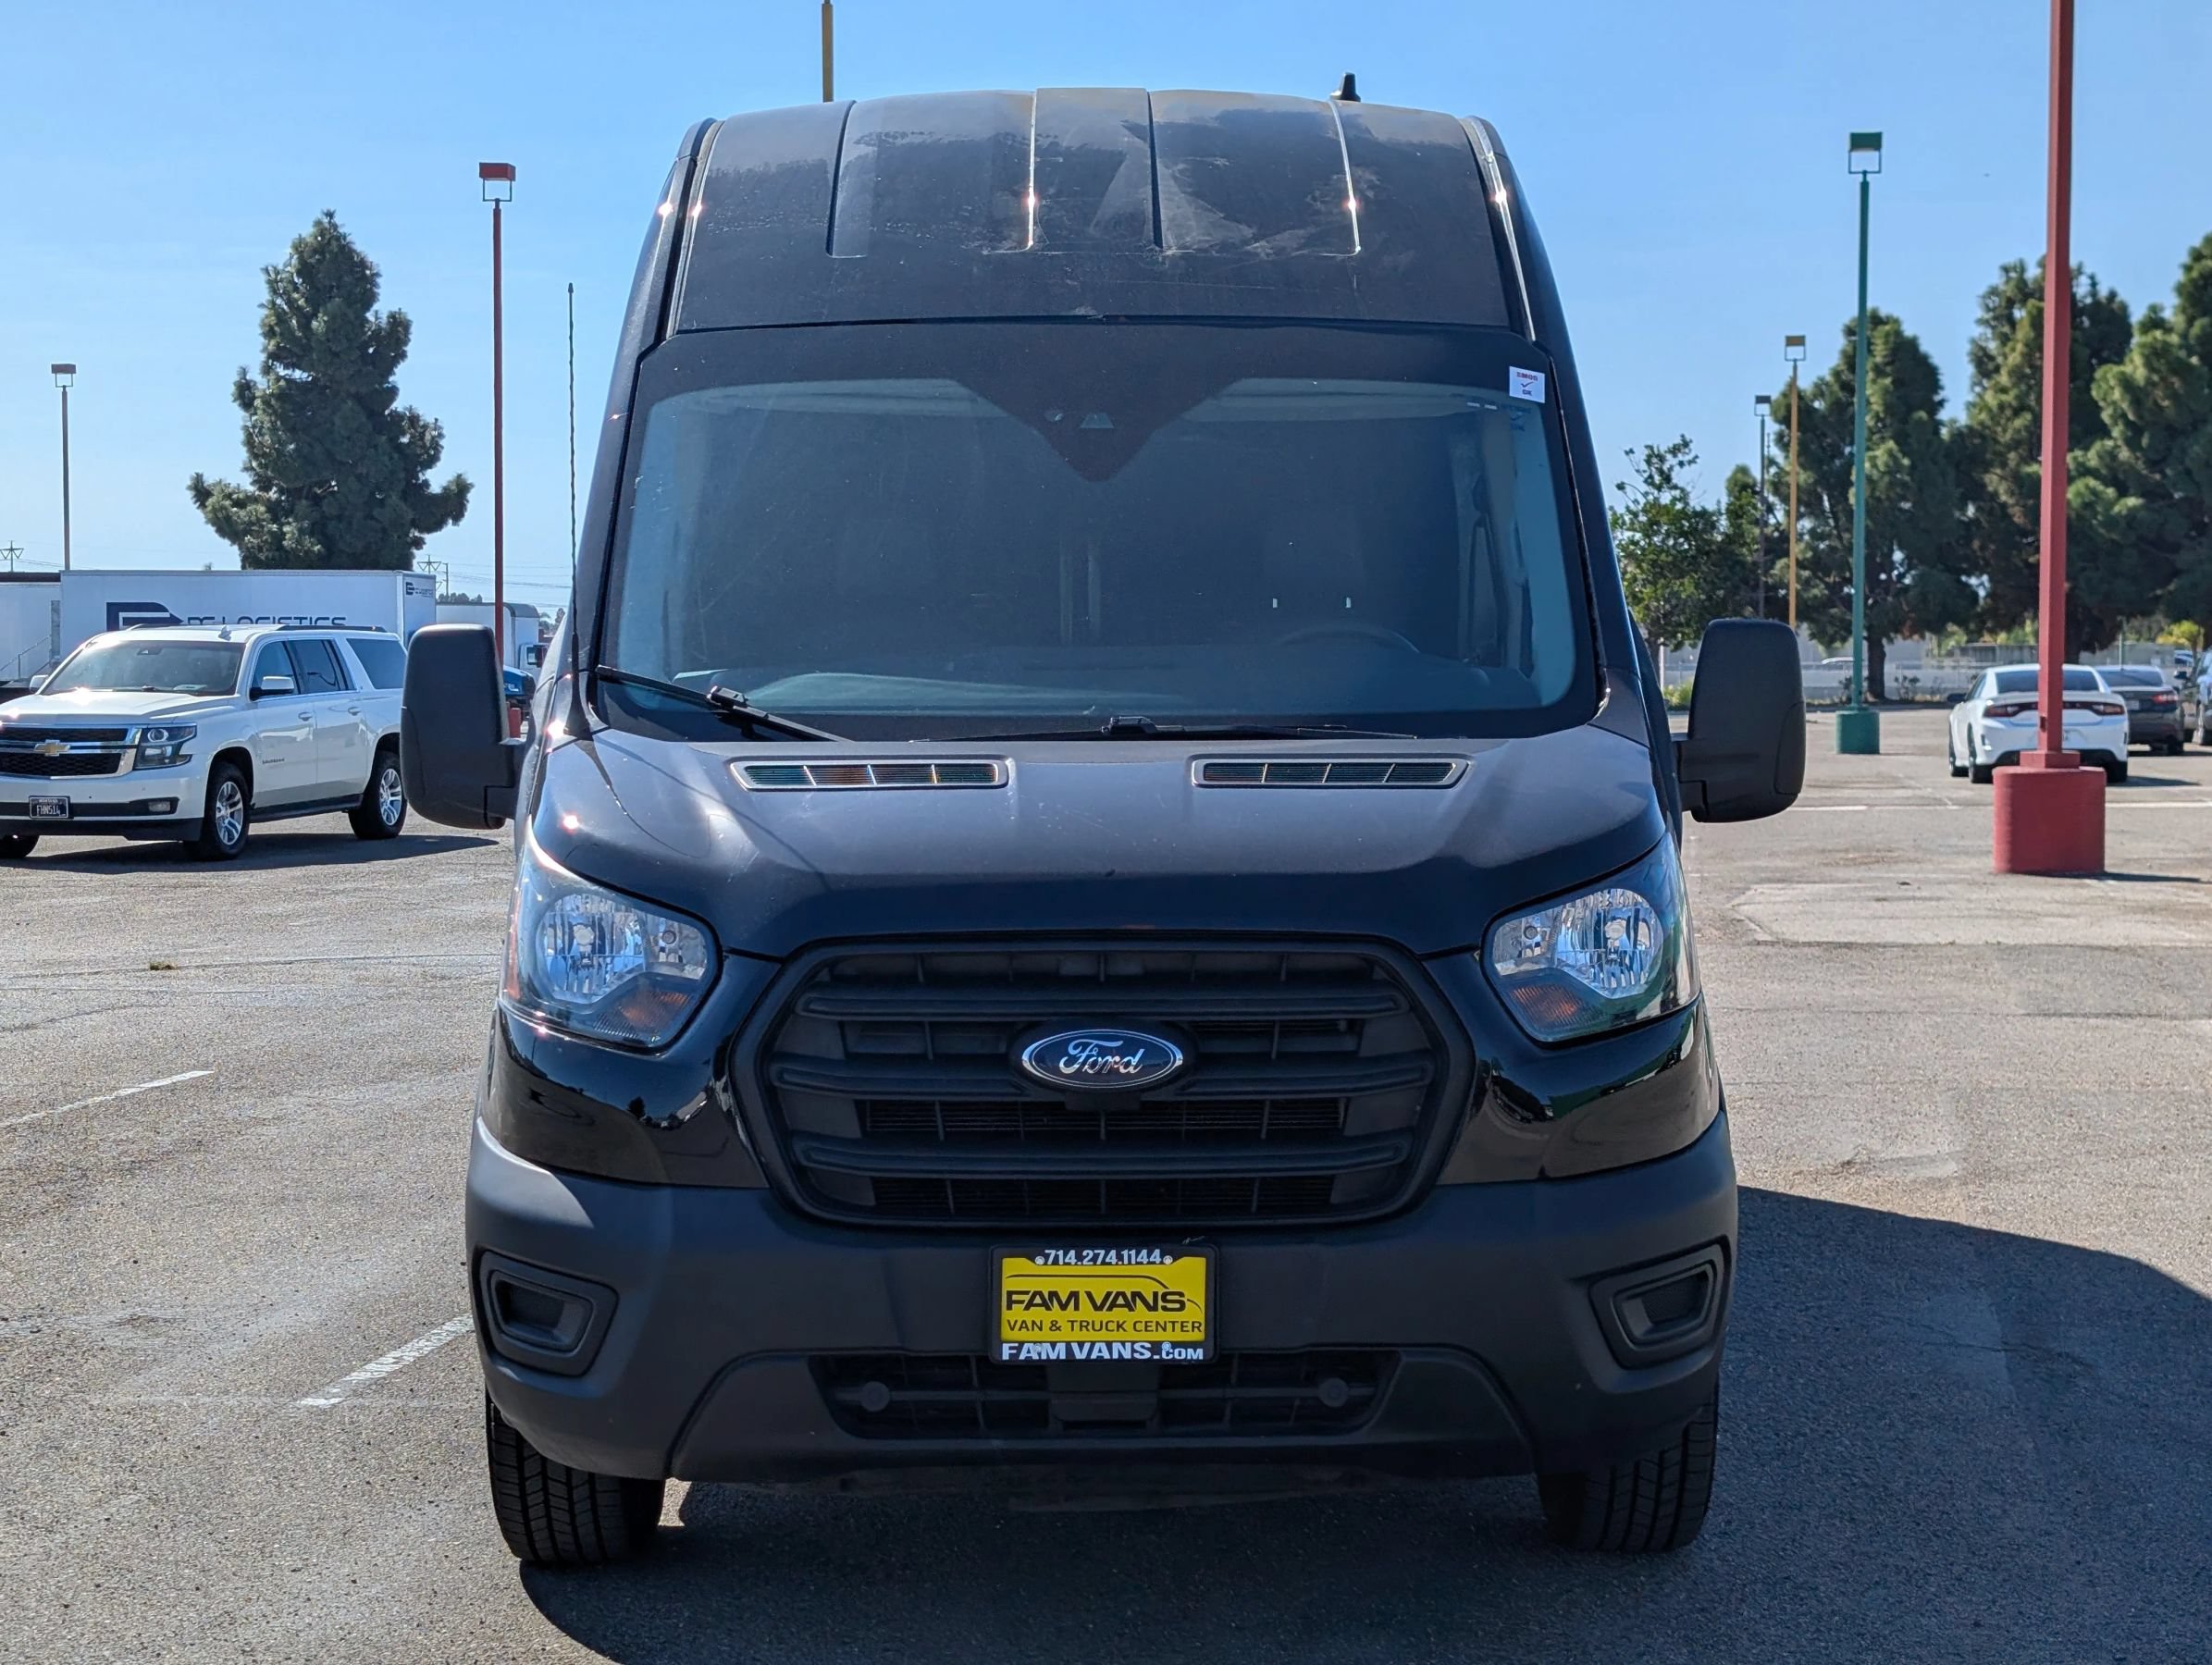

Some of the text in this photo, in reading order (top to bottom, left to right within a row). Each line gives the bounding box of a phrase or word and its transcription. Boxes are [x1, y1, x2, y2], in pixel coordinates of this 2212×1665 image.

[1059, 1039, 1145, 1074] Ford
[1044, 1249, 1162, 1265] 714.274.1144
[1006, 1290, 1186, 1313] FAM VANS
[1007, 1319, 1203, 1333] VAN & TRUCK CENTER
[1002, 1342, 1067, 1361] FAM
